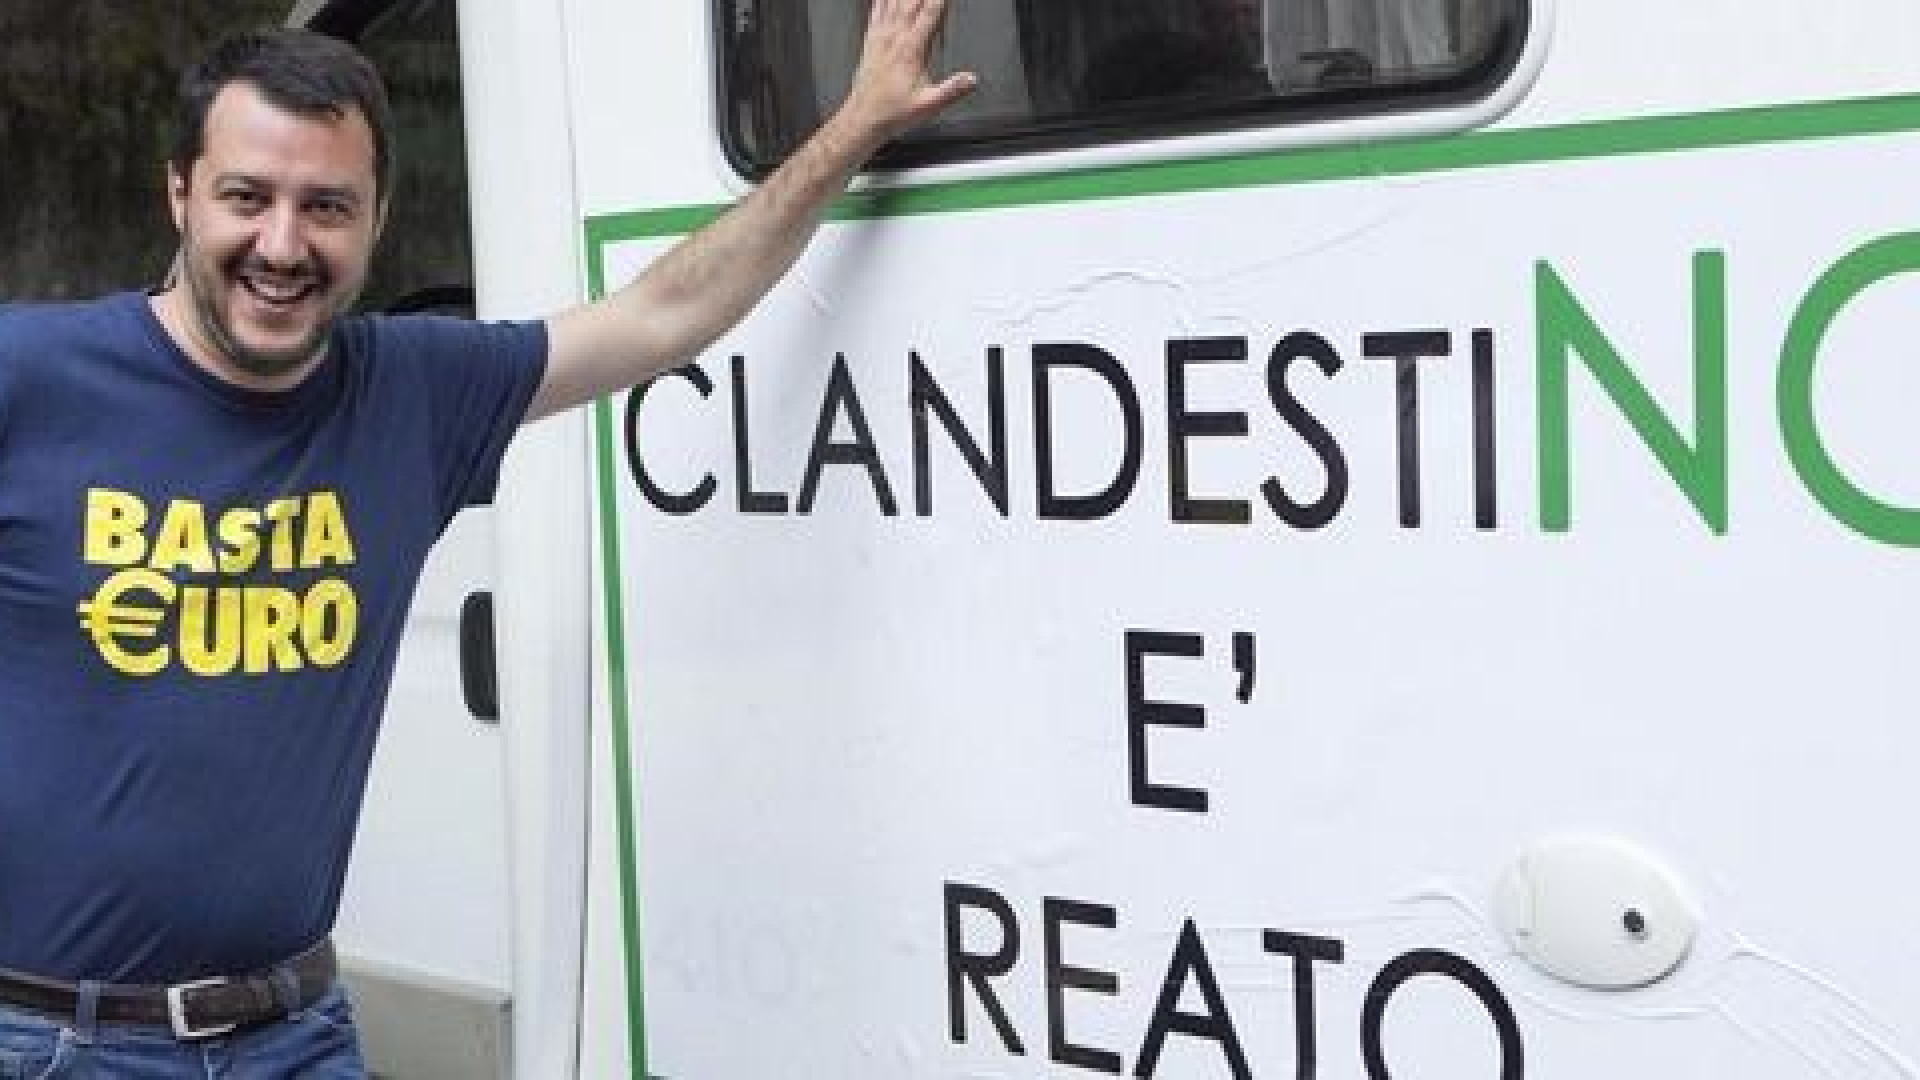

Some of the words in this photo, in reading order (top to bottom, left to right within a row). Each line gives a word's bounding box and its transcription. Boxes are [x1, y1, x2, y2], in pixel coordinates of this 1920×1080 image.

[83, 487, 356, 574] BASTA
[78, 567, 358, 677] €URO
[943, 880, 1524, 1080] REATO
